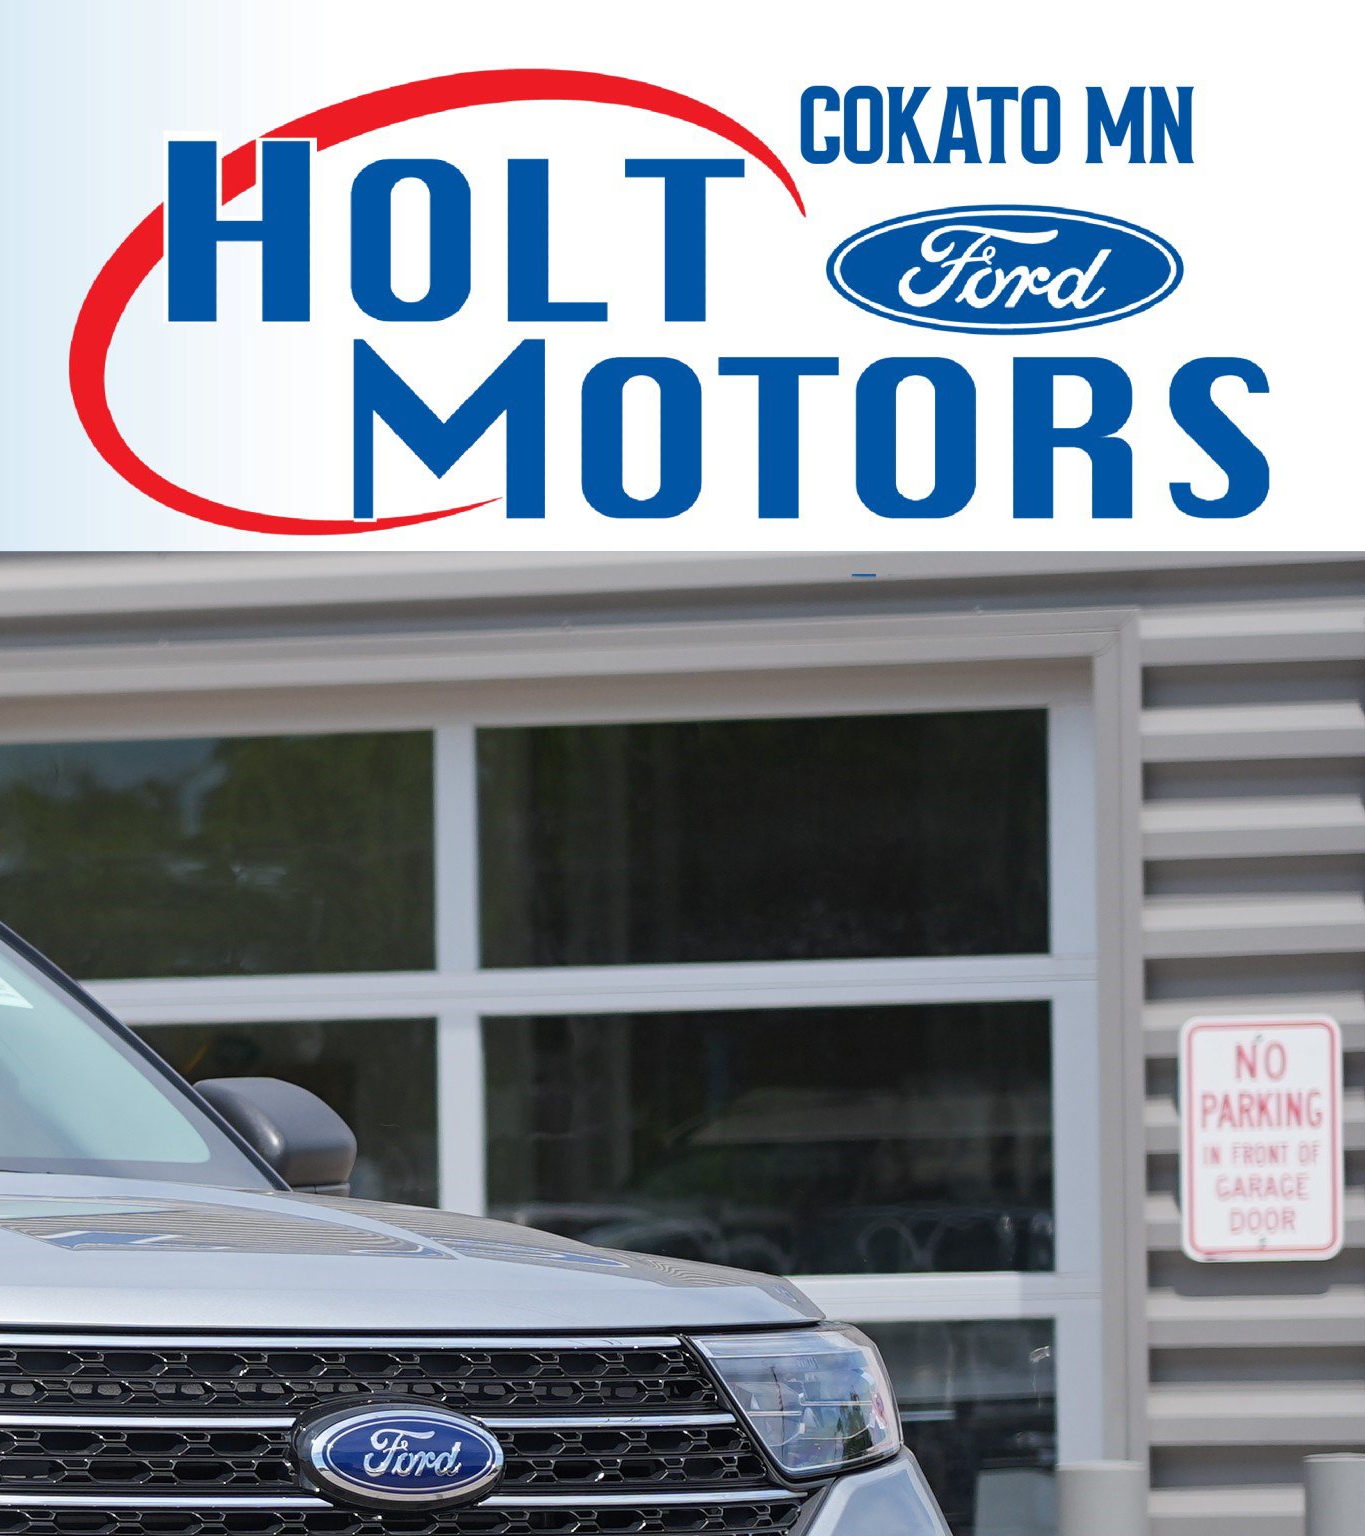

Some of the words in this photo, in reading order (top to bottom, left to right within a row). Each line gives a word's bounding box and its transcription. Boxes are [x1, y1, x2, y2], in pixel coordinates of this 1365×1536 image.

[1235, 1041, 1287, 1082] NO
[1200, 1090, 1324, 1129] PARKING
[1203, 1144, 1221, 1165] IN
[1232, 1142, 1288, 1167] FRONT
[1298, 1140, 1320, 1166] OF
[1216, 1172, 1310, 1200] GARAGE
[1229, 1207, 1296, 1235] DOOR
[363, 1428, 462, 1477] Ford
